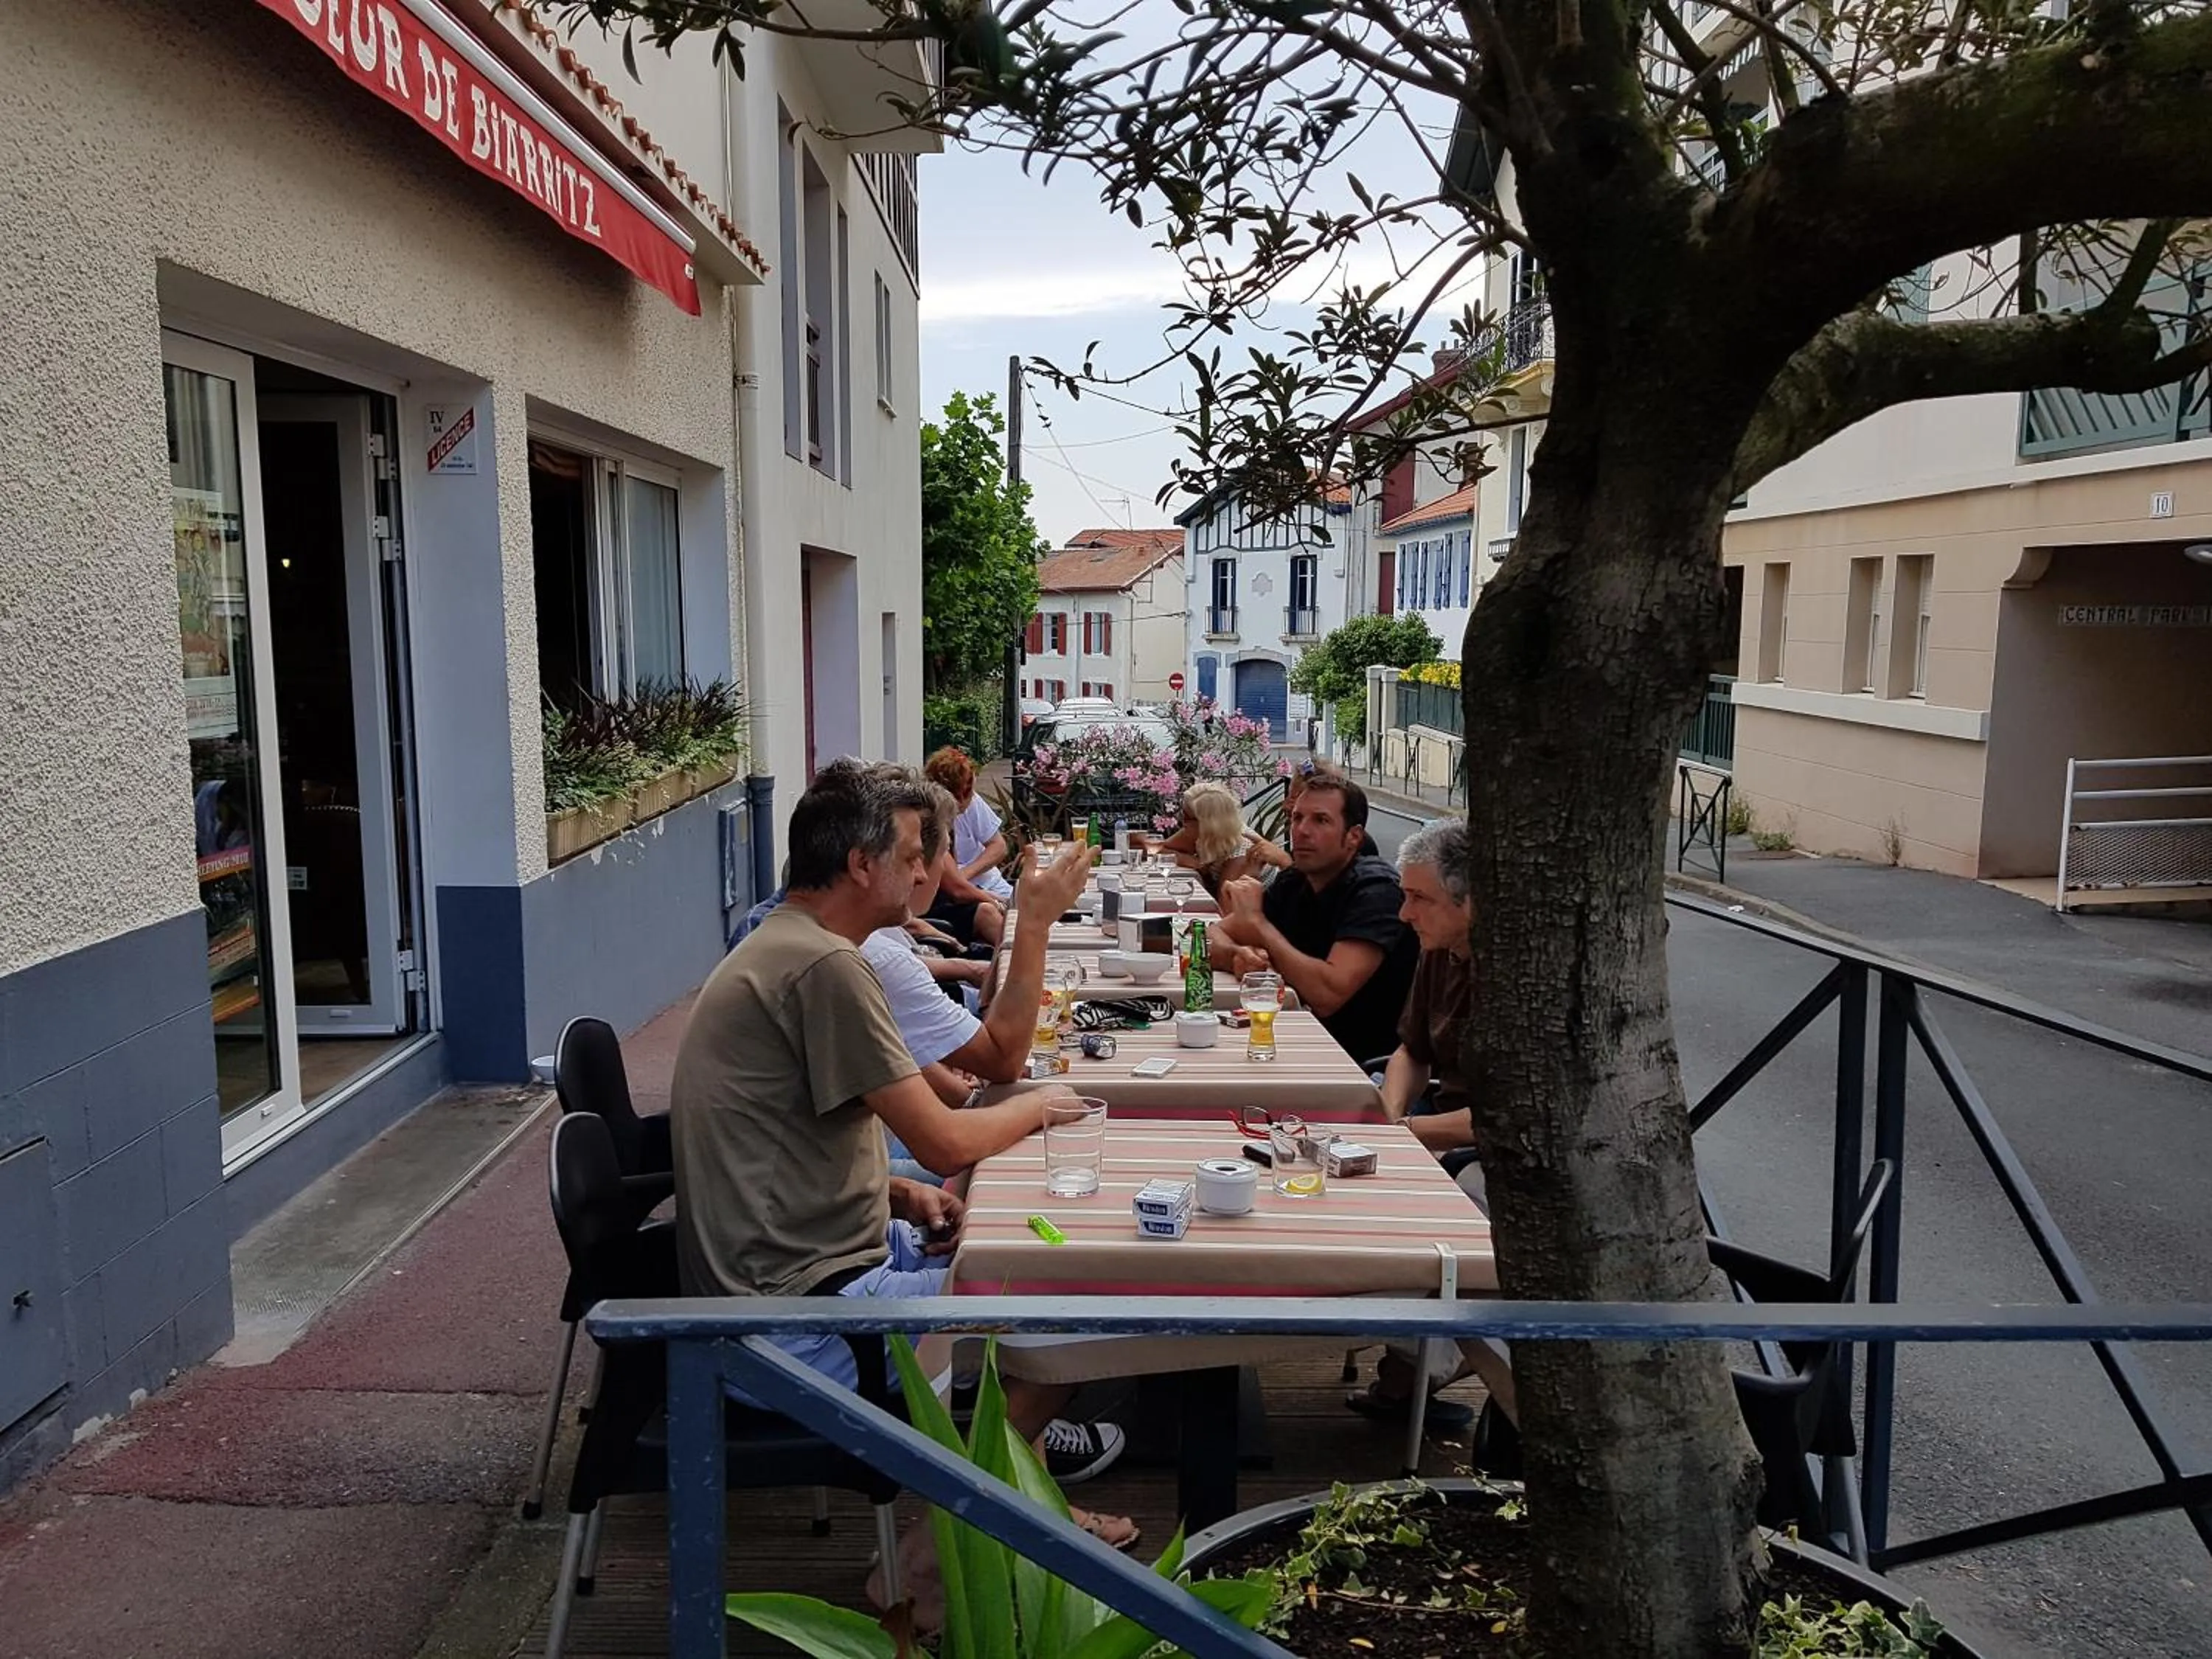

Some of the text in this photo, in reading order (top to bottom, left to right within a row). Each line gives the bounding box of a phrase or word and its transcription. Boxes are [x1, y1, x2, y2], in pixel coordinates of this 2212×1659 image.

[418, 39, 459, 140] DE
[429, 411, 444, 424] IV
[431, 413, 472, 465] LICENCE
[2156, 497, 2168, 513] 10
[2065, 607, 2136, 622] CENTRAL
